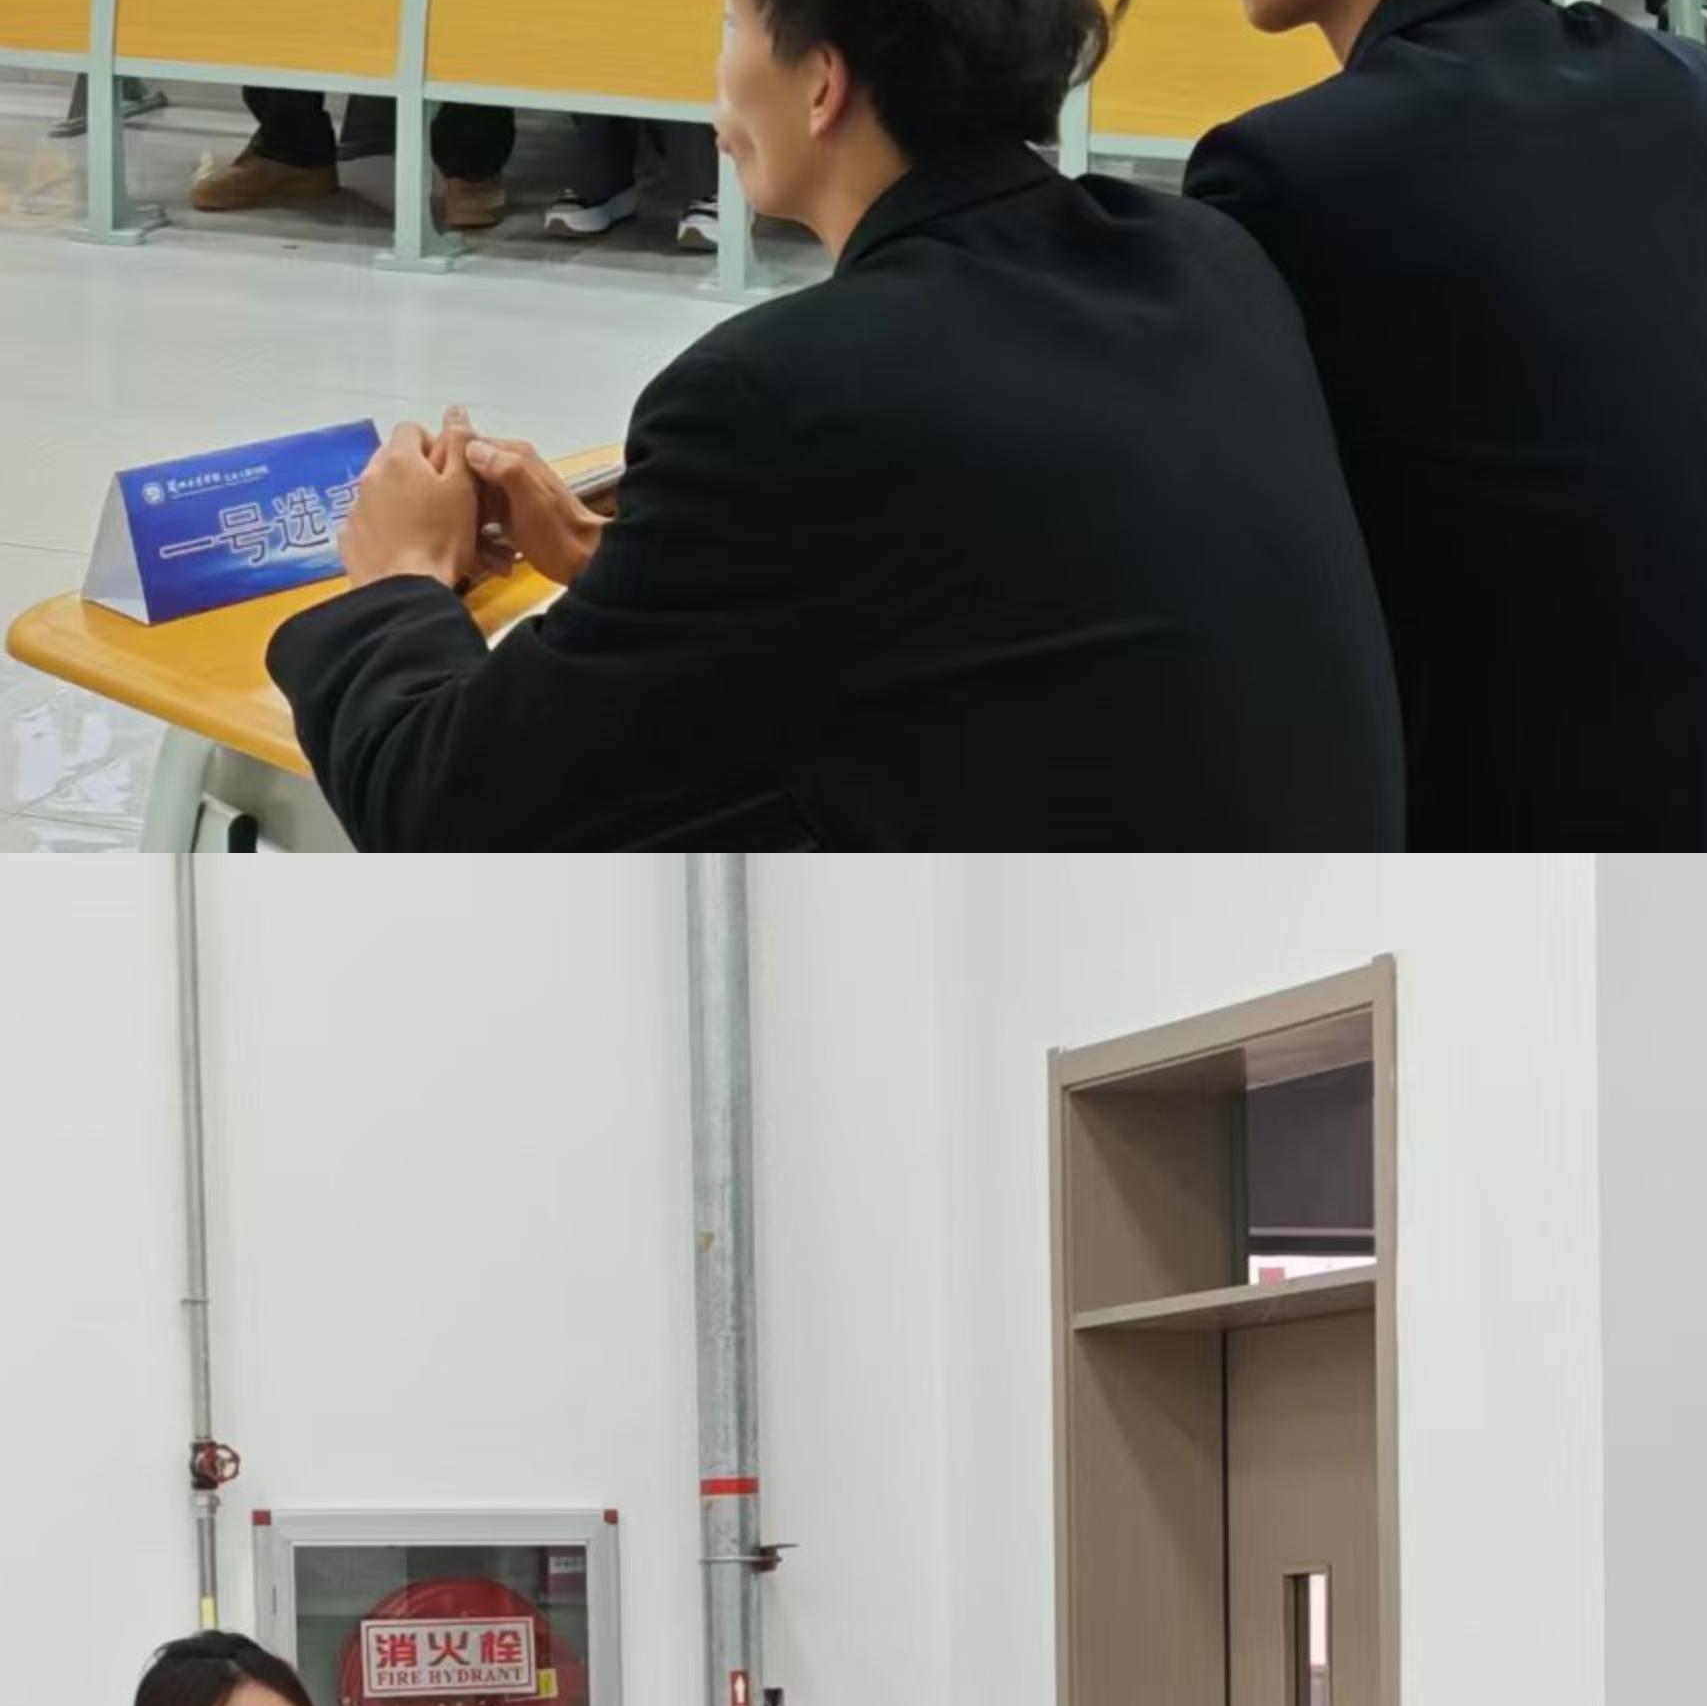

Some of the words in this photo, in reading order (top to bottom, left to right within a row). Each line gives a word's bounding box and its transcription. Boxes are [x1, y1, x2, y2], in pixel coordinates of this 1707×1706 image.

[375, 1631, 522, 1668] 消火栓
[377, 1670, 423, 1686] FIRE
[429, 1667, 523, 1684] HYDRANT
